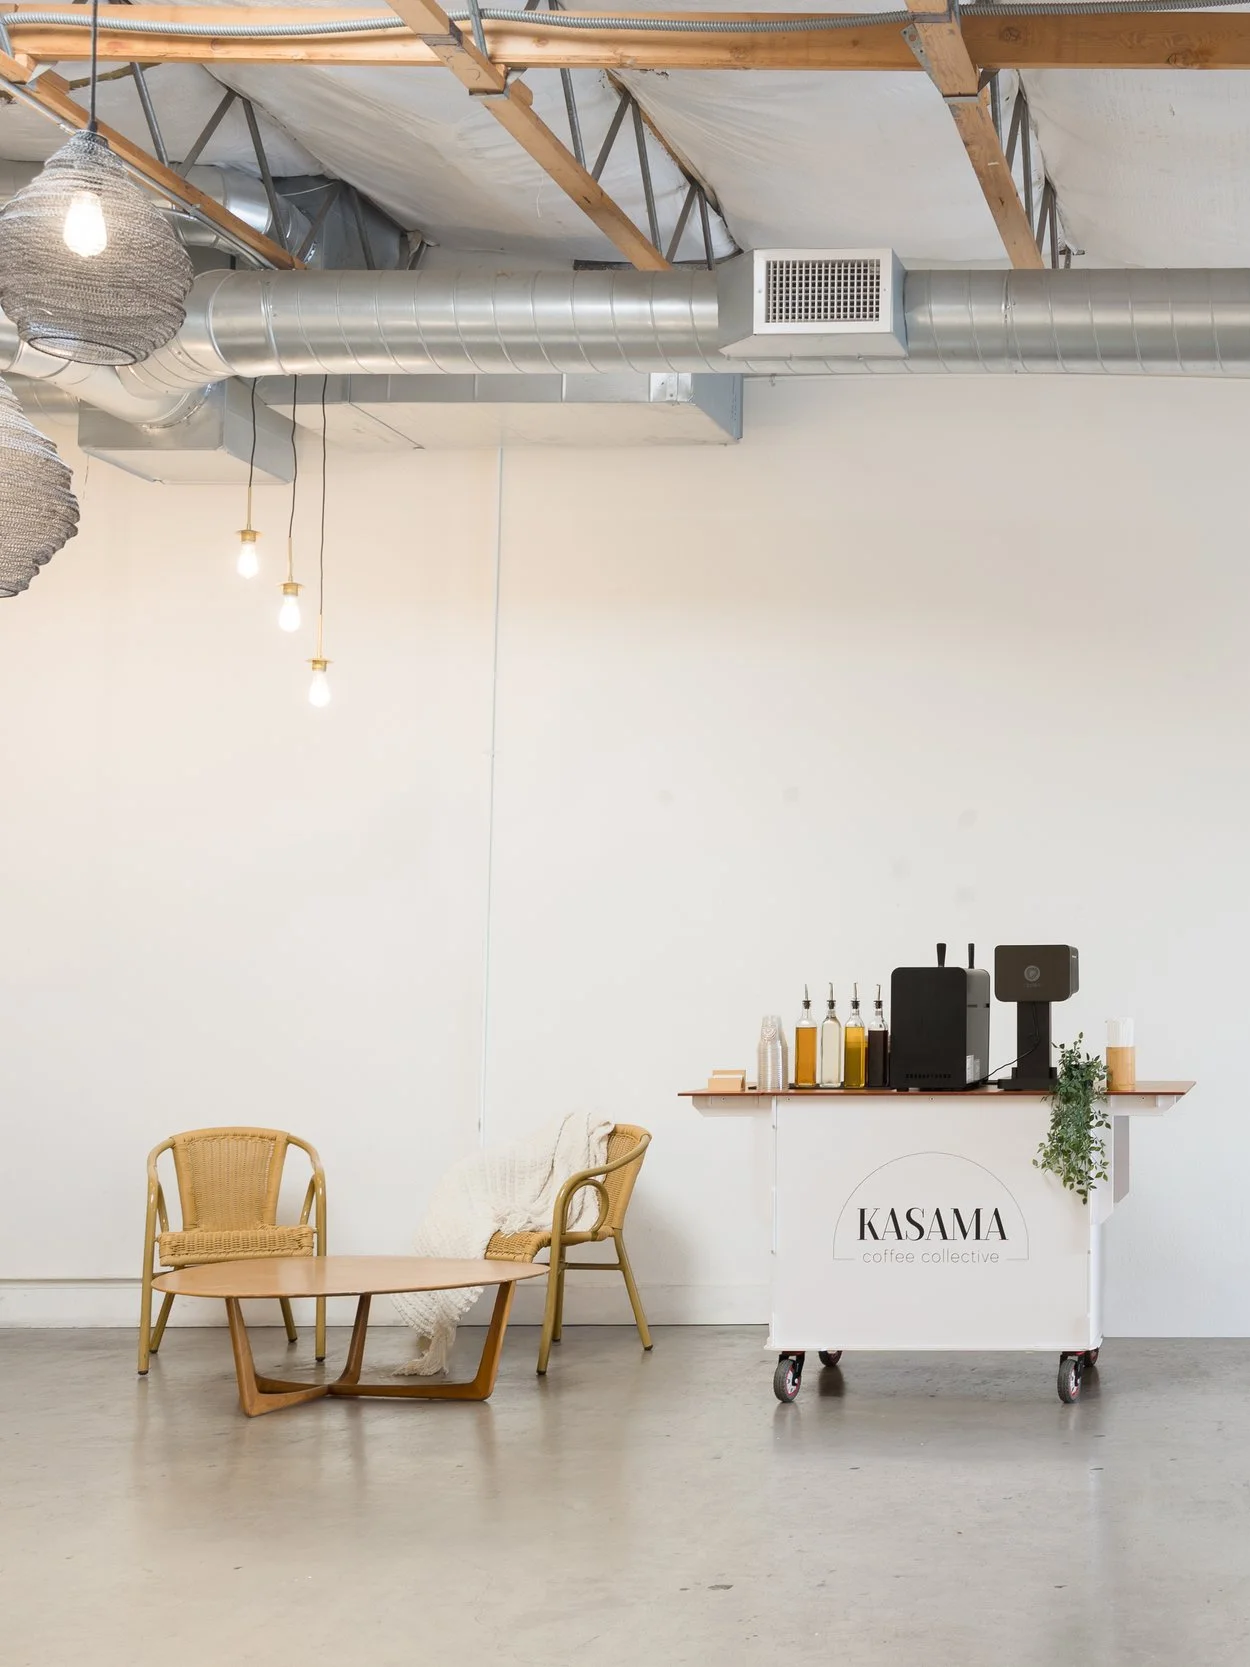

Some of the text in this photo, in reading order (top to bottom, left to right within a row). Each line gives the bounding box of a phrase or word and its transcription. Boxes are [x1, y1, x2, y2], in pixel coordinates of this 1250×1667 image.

[857, 1207, 1009, 1241] KASAMA
[862, 1248, 999, 1264] coffee collective
